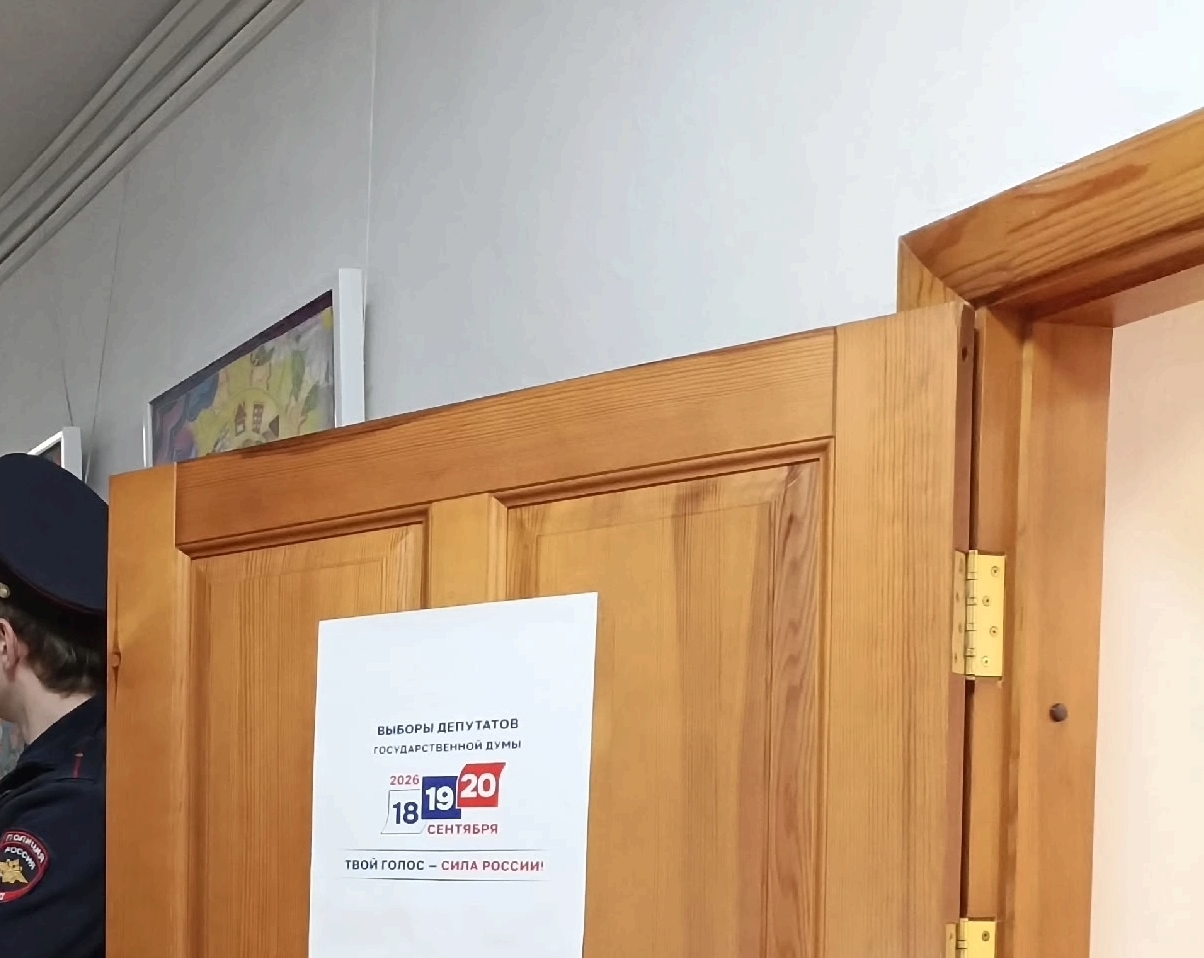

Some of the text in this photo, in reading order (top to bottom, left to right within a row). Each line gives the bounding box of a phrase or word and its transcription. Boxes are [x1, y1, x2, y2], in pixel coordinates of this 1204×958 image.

[377, 718, 519, 736] ВЫБОРЫ ДЕПУТАТОВ
[373, 740, 522, 755] ГОСУДАРСТВЕННОЙ ДУМЫ
[389, 774, 420, 786] 2026
[392, 772, 496, 825] 18 19 20
[427, 823, 498, 835] СЕНТЯБРЯ
[4, 846, 36, 870] РОССИЯ
[345, 857, 378, 870] ТВОЙ
[381, 859, 425, 871] ГОЛОС
[441, 860, 478, 871] СИЛА
[482, 860, 544, 872] РОССИИ!
